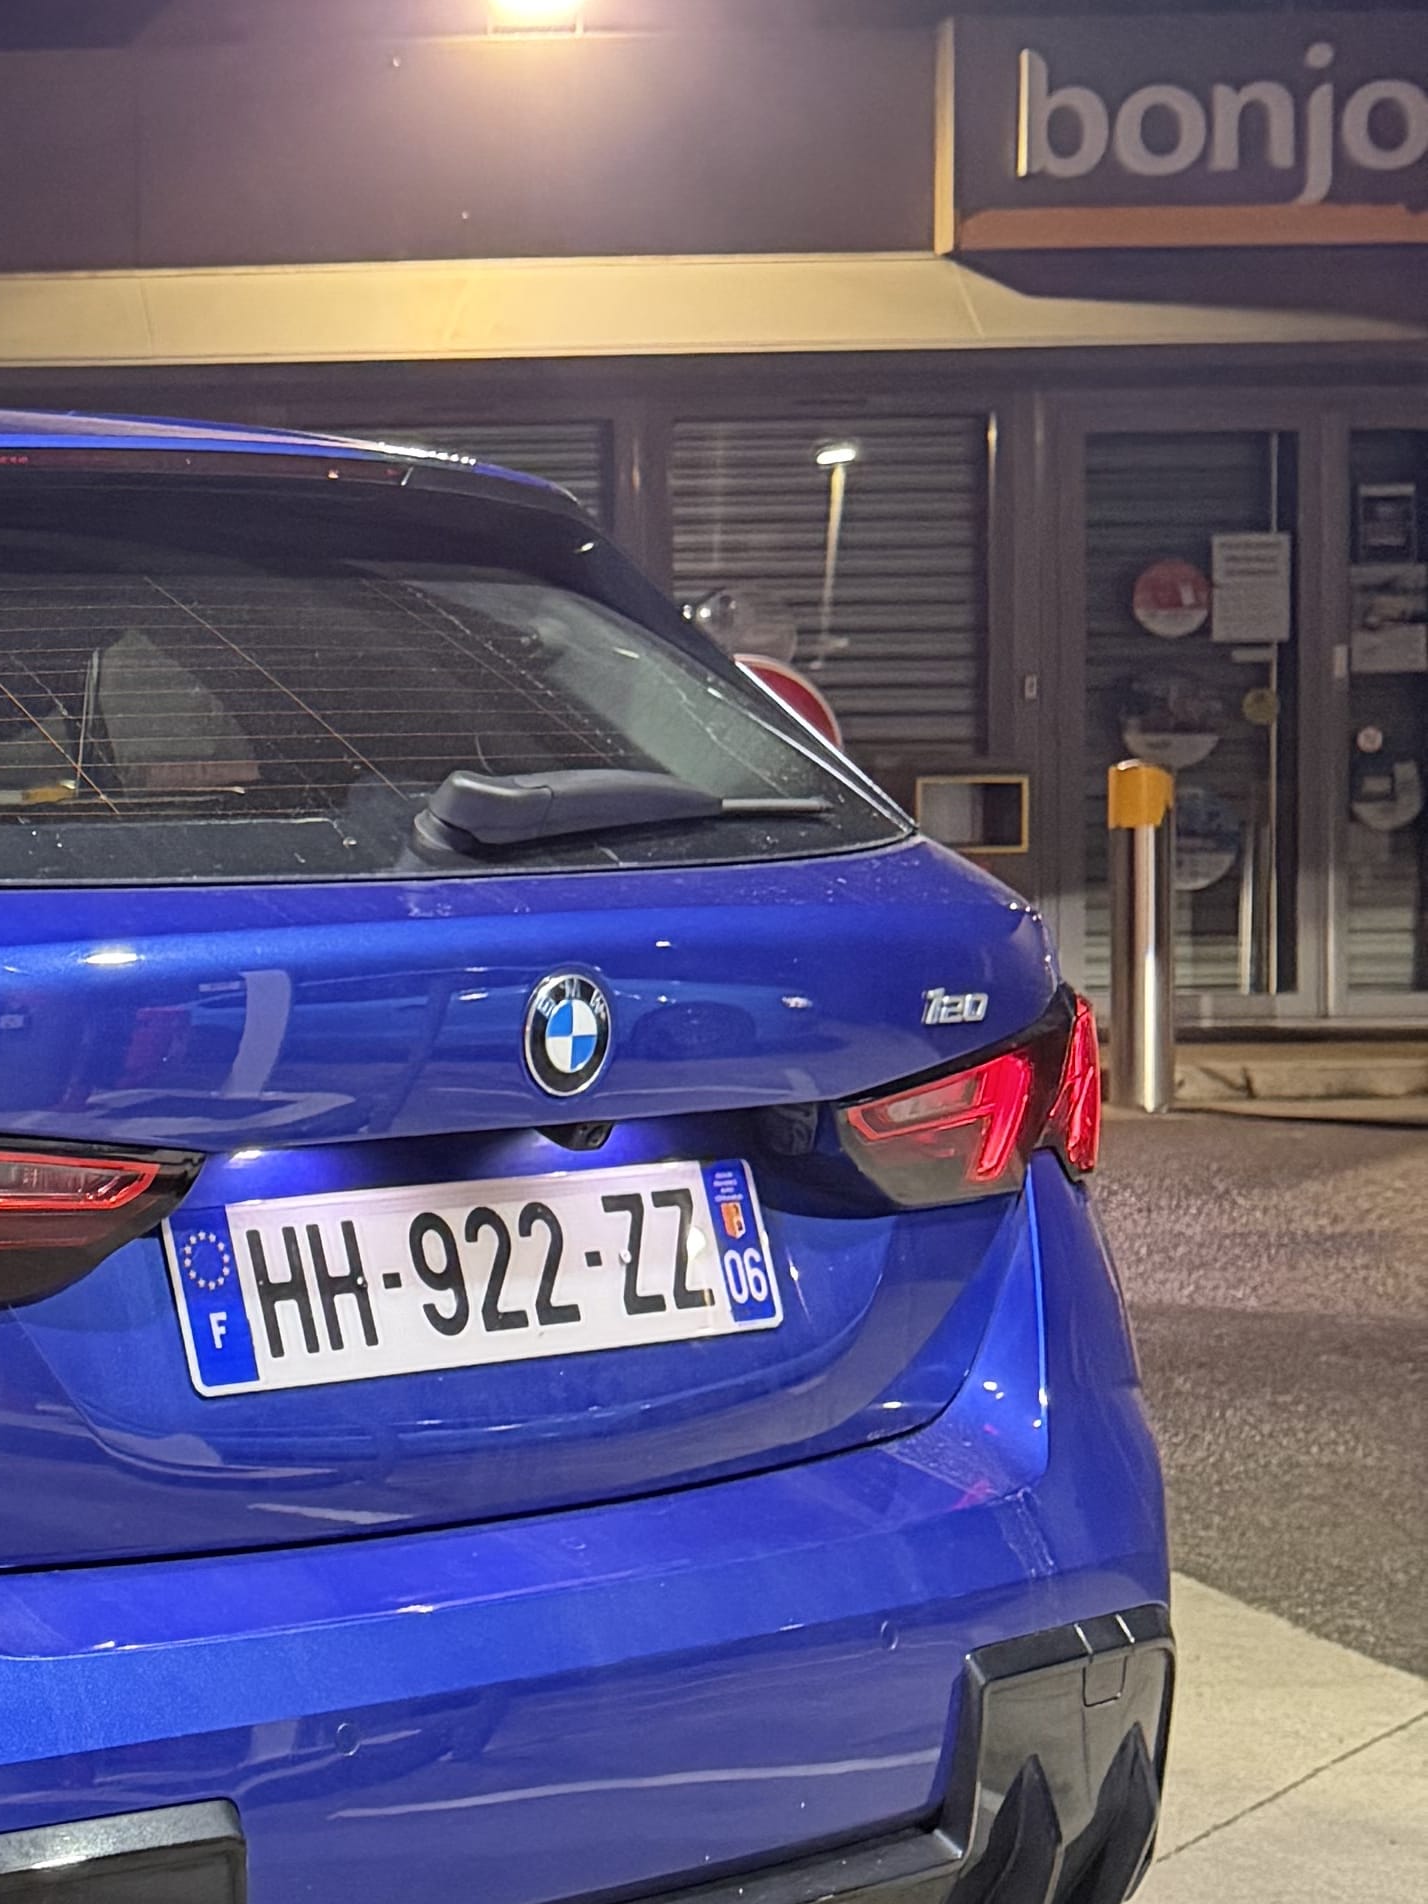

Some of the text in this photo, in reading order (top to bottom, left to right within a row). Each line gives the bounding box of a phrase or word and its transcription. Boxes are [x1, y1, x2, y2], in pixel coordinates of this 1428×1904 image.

[922, 987, 988, 1025] 120
[245, 1187, 716, 1359] HH-922-ZZ
[724, 1247, 768, 1304] 06
[208, 1310, 228, 1349] F
